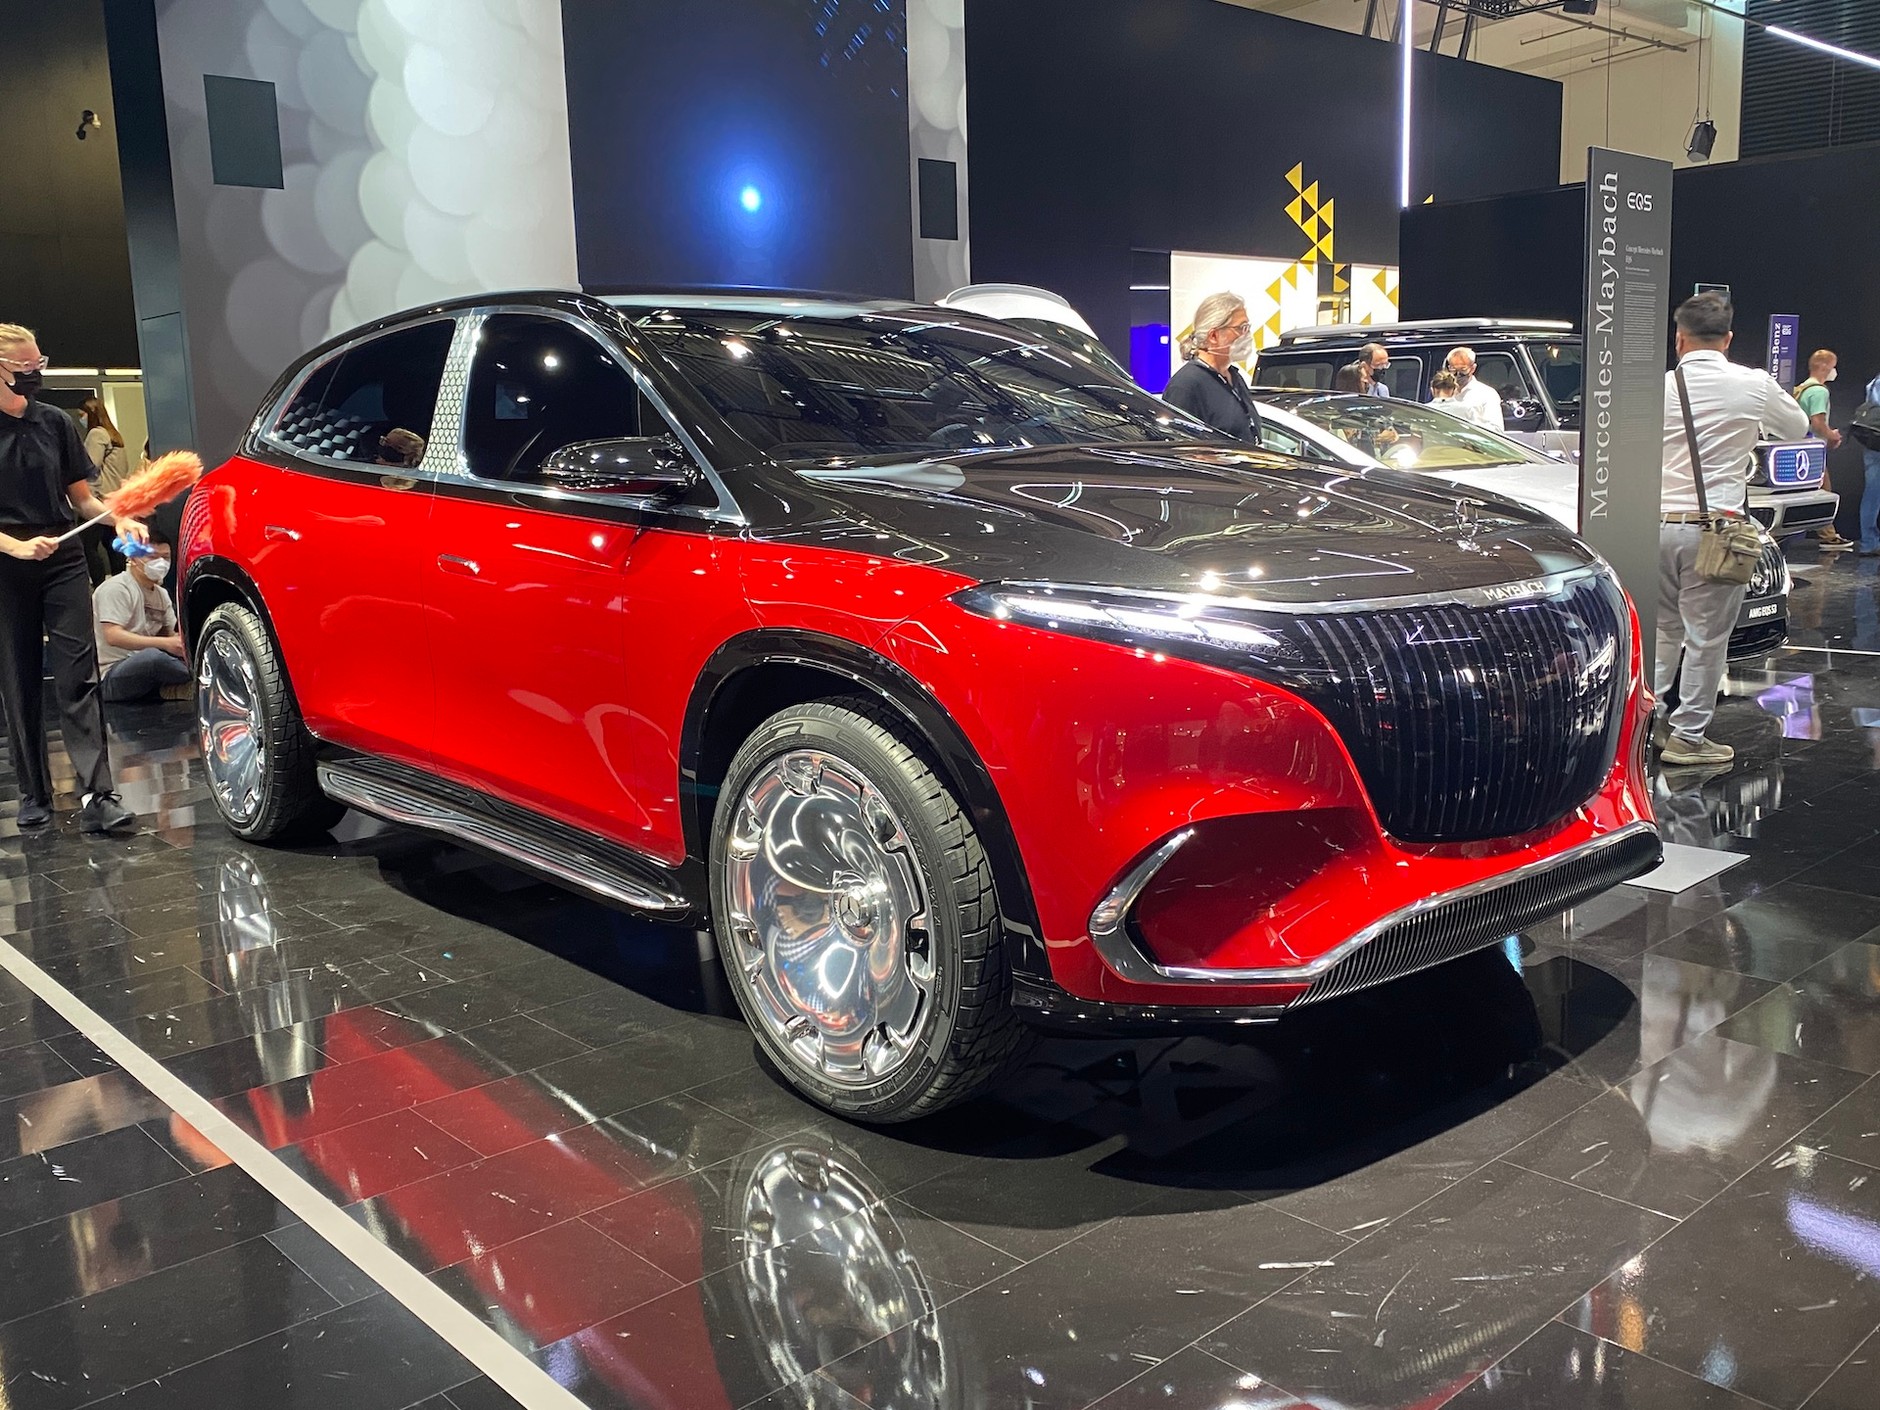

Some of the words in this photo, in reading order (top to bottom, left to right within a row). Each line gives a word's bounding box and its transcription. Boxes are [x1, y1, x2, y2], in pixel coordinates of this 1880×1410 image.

[1627, 191, 1653, 212] EQS
[1590, 172, 1619, 520] Mercedes-Maybach
[1482, 581, 1547, 601] MAYBACH
